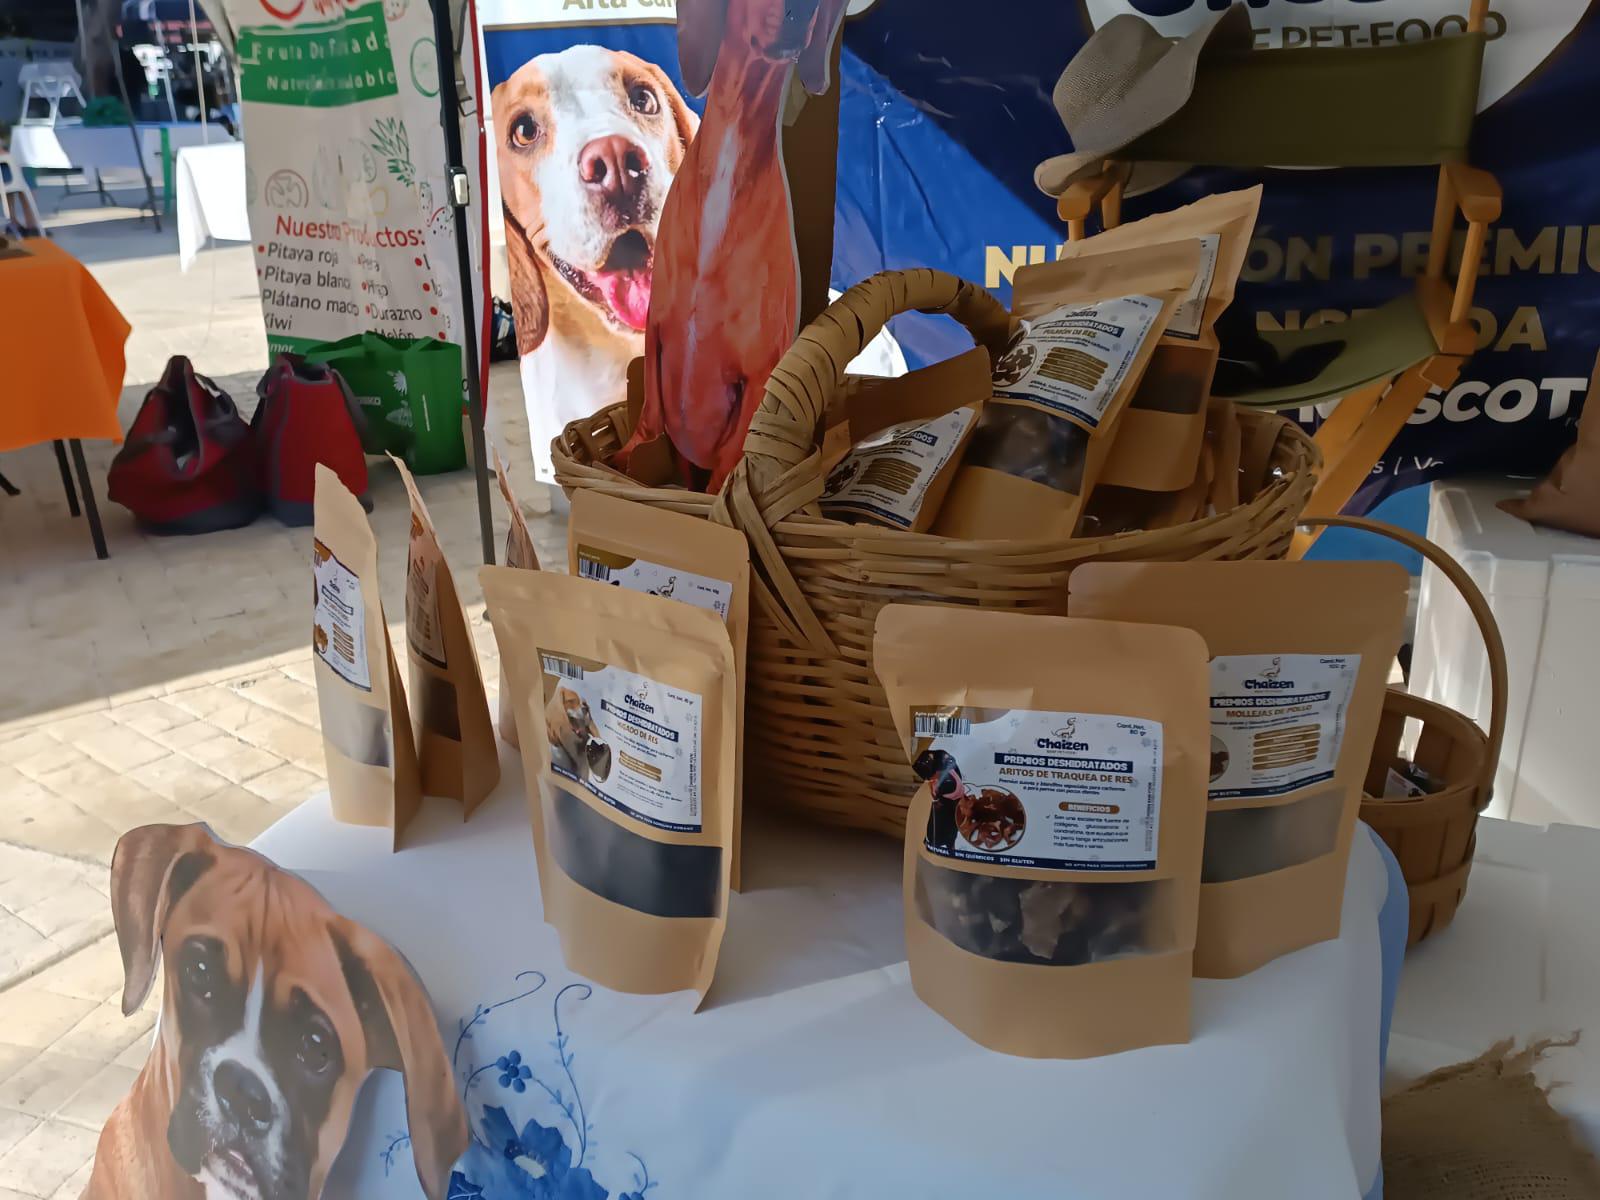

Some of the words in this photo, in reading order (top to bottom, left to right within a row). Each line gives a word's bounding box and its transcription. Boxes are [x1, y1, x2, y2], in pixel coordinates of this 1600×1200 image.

[267, 243, 313, 262] Pitaya
[1354, 225, 1600, 280] PREMI
[264, 266, 311, 286] Pitaya
[262, 289, 322, 311] Plátano
[370, 303, 423, 321] Durazno
[1244, 679, 1294, 689] Chaizen
[624, 694, 654, 714] Chaizen
[1226, 710, 1273, 718] MOLLEJAS
[1037, 738, 1089, 751] Chaizen
[1003, 755, 1046, 767] PREMIOS
[1047, 757, 1128, 771] DESHIDRATADOS
[999, 767, 1034, 777] ARITOS
[1036, 770, 1048, 778] DE
[1051, 771, 1098, 782] TRAQUEA
[1100, 775, 1113, 783] DE
[1115, 775, 1133, 784] RES
